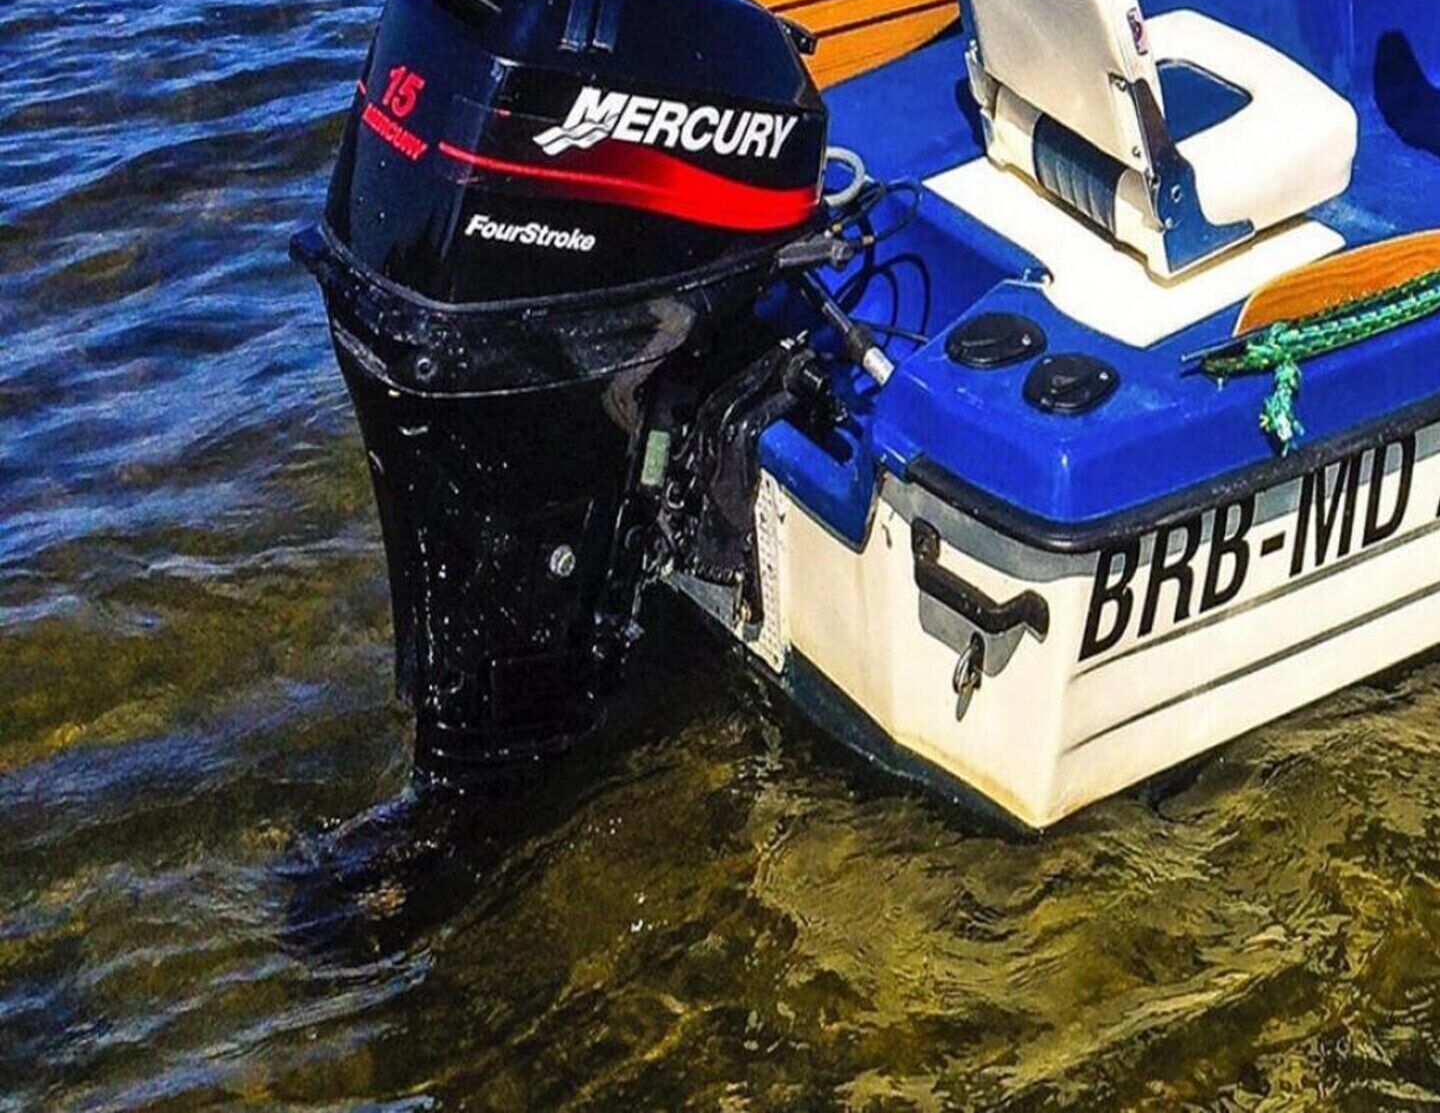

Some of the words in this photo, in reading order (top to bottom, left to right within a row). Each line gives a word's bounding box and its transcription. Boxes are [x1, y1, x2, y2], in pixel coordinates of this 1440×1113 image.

[382, 66, 426, 117] 15
[562, 87, 798, 159] MERCURY
[465, 214, 596, 252] FourStroke
[1078, 431, 1418, 662] BRB-MD
